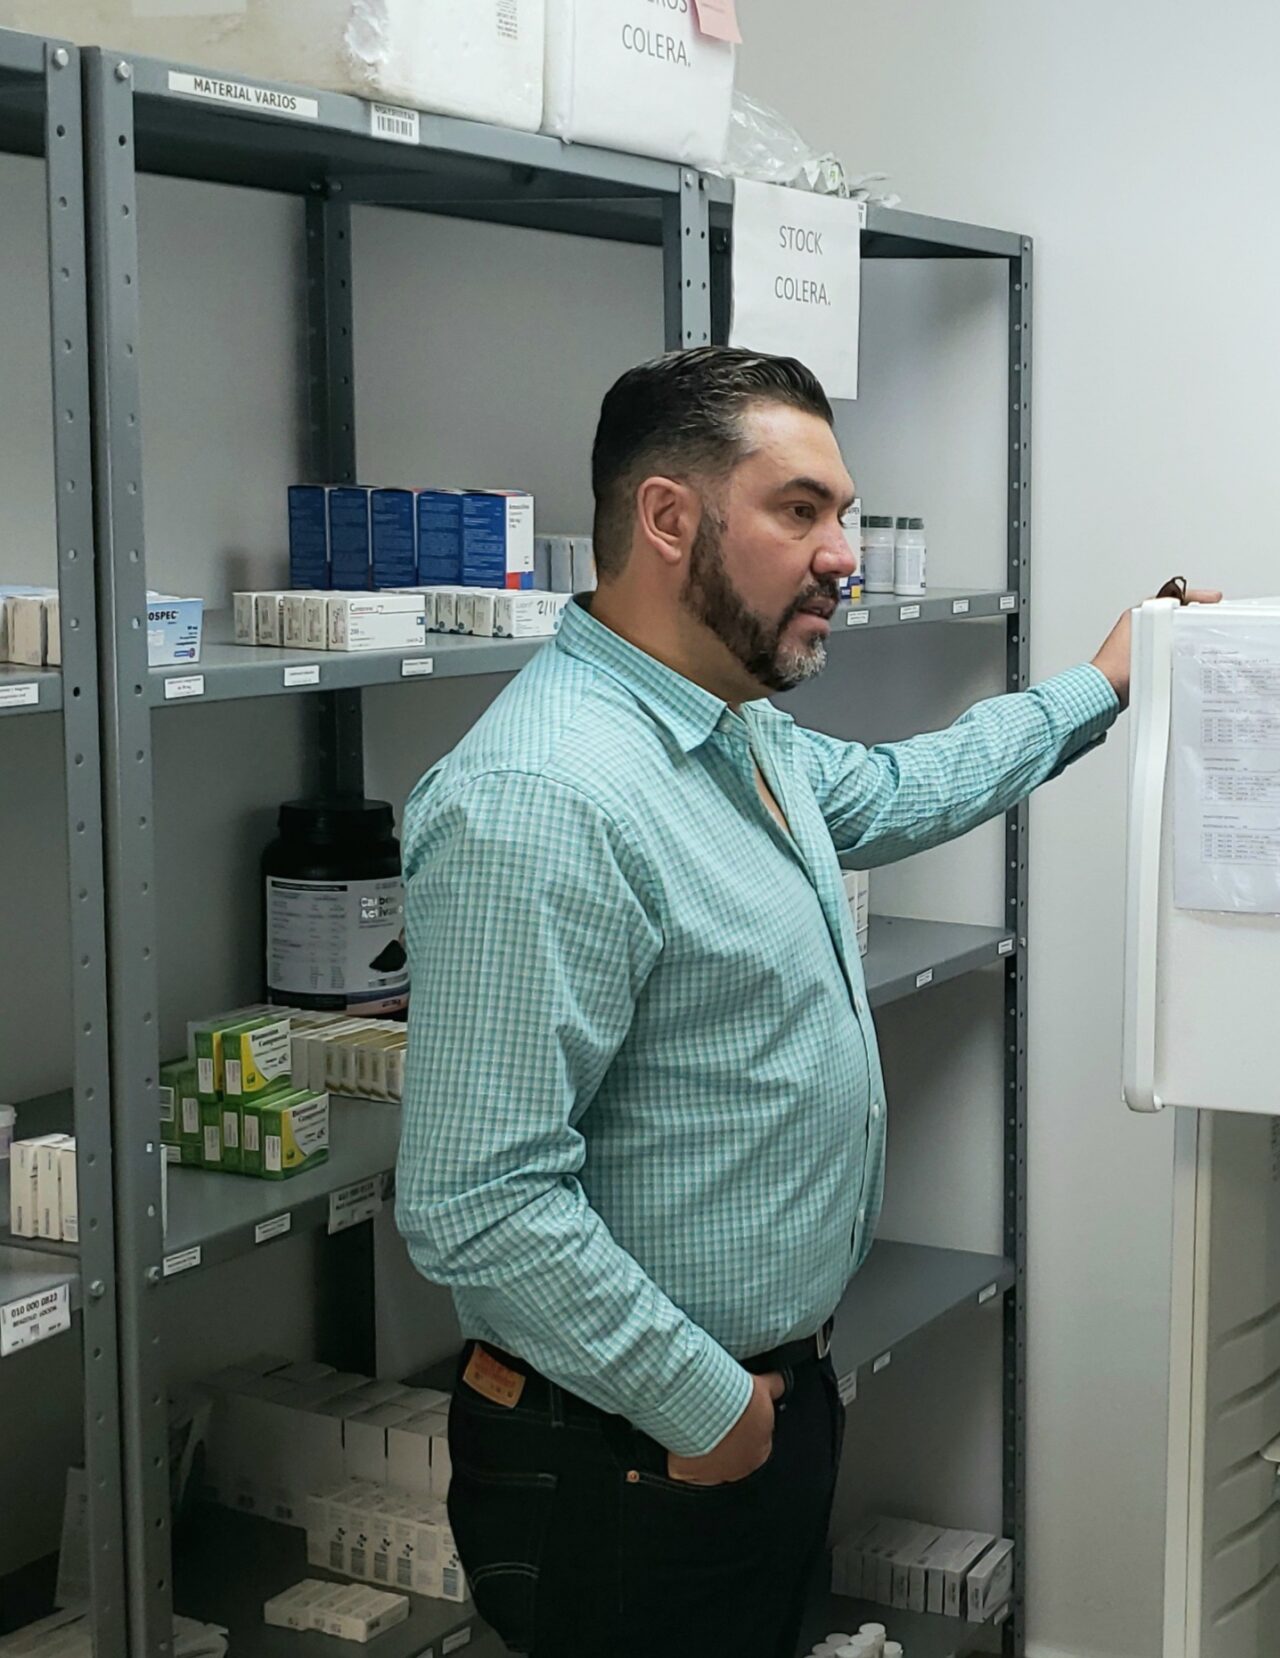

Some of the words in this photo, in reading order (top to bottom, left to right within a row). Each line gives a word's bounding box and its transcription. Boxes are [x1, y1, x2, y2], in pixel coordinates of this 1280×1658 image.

[622, 24, 691, 67] COLERA.
[193, 77, 252, 101] MATERIAL
[254, 89, 297, 110] VARIOS
[779, 225, 823, 255] STOCK
[774, 275, 831, 306] COLERA.
